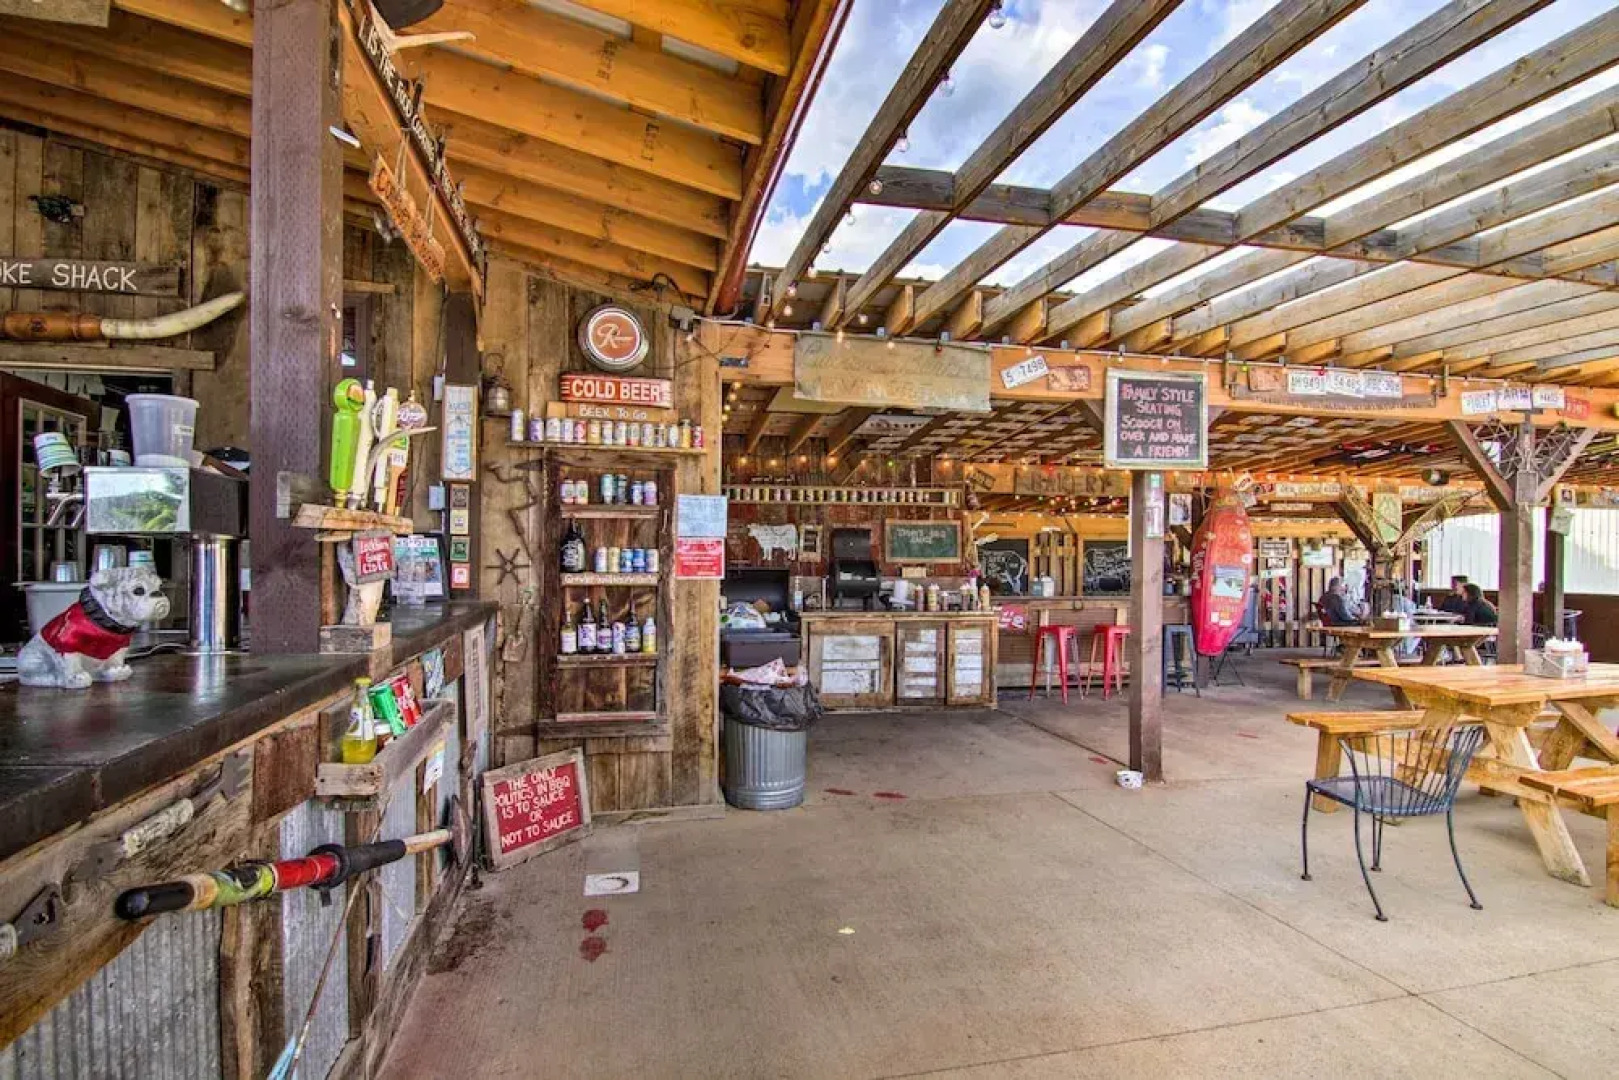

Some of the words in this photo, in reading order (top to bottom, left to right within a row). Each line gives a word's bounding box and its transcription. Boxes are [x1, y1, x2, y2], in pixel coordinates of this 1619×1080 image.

[0, 261, 33, 284] KE
[51, 263, 137, 291] SHACK
[571, 378, 616, 399] COLD
[620, 381, 660, 401] BEER
[1160, 387, 1195, 403] STYLE
[1120, 430, 1146, 442] OVER
[1148, 431, 1170, 443] AND
[1134, 445, 1143, 457] A
[507, 775, 529, 791] THE
[530, 767, 557, 784] ONLY
[493, 786, 535, 807] POLITICS
[536, 781, 548, 796] IN
[549, 775, 571, 791] BBQ
[501, 805, 514, 819] IS
[515, 800, 530, 814] TO
[532, 789, 566, 809] SAUCE
[529, 809, 544, 823] OR
[501, 828, 523, 848] NOT
[524, 824, 540, 838] TO
[542, 810, 574, 833] SAUCE
